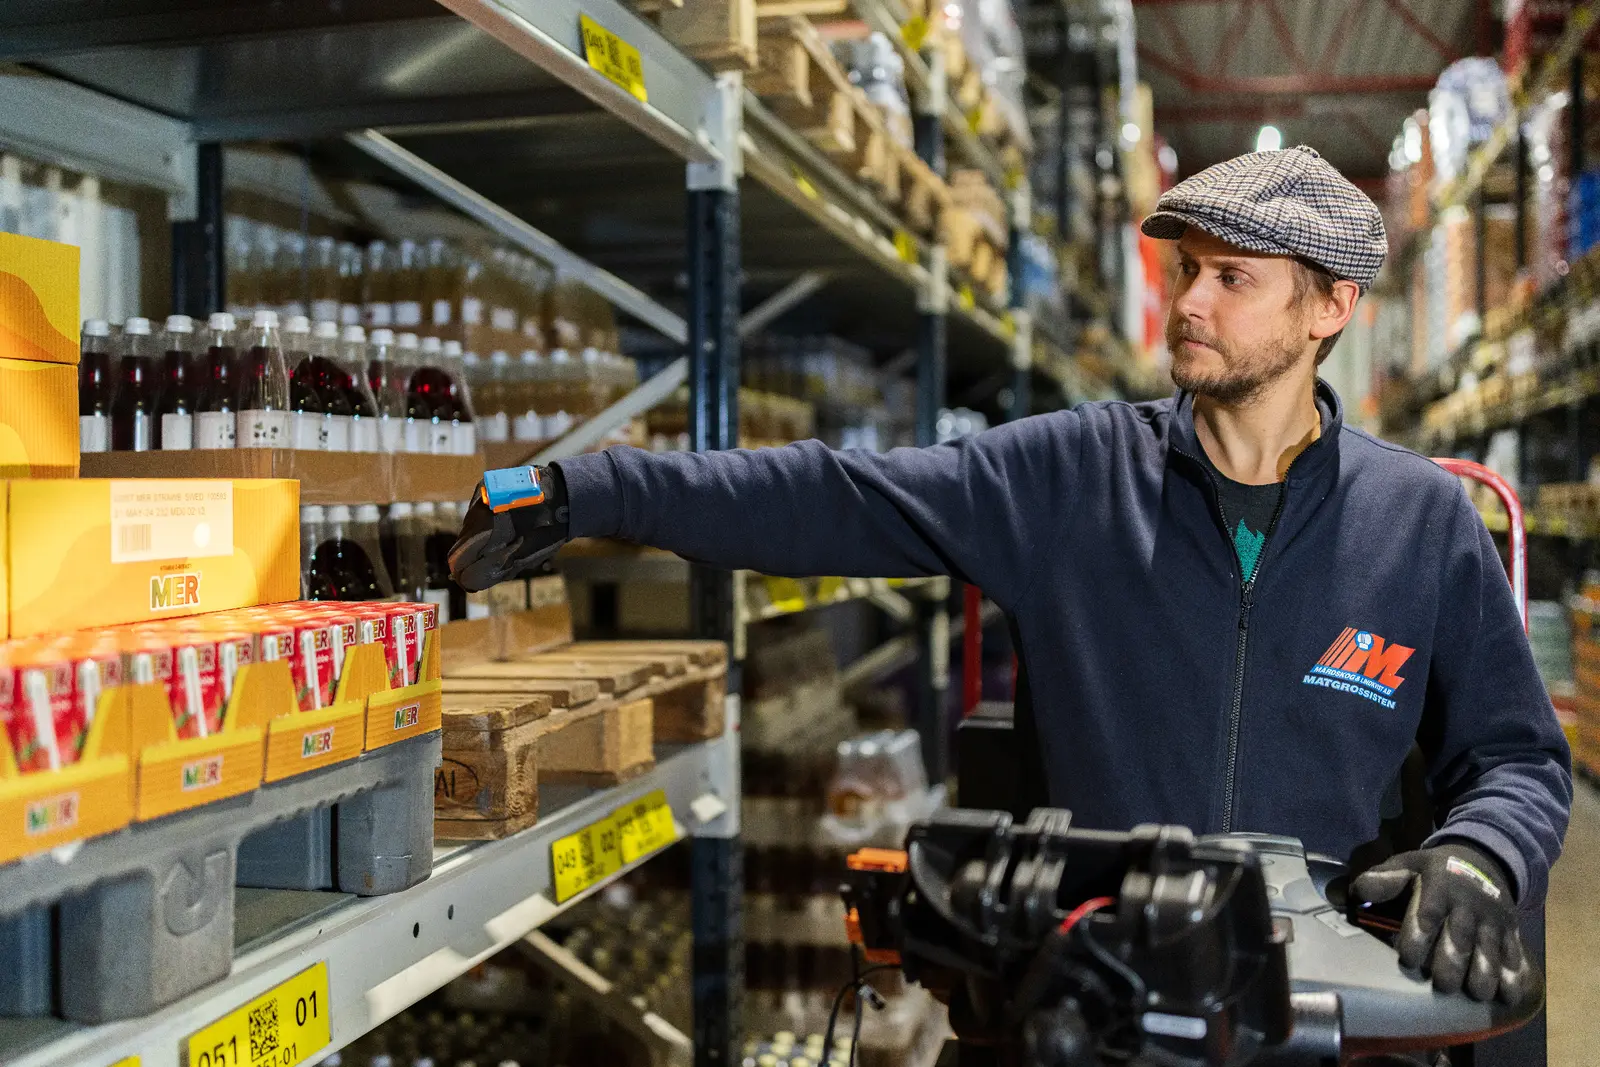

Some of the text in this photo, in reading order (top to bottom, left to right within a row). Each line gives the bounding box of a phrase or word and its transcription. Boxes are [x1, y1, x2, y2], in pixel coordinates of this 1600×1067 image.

[151, 574, 199, 609] MER
[1302, 675, 1397, 710] MATGROSSISTEN
[1383, 687, 1392, 695] AB
[395, 705, 419, 729] MER
[303, 730, 332, 757] MER
[199, 990, 318, 1067] 051 01
[257, 1042, 297, 1067] 1-01
